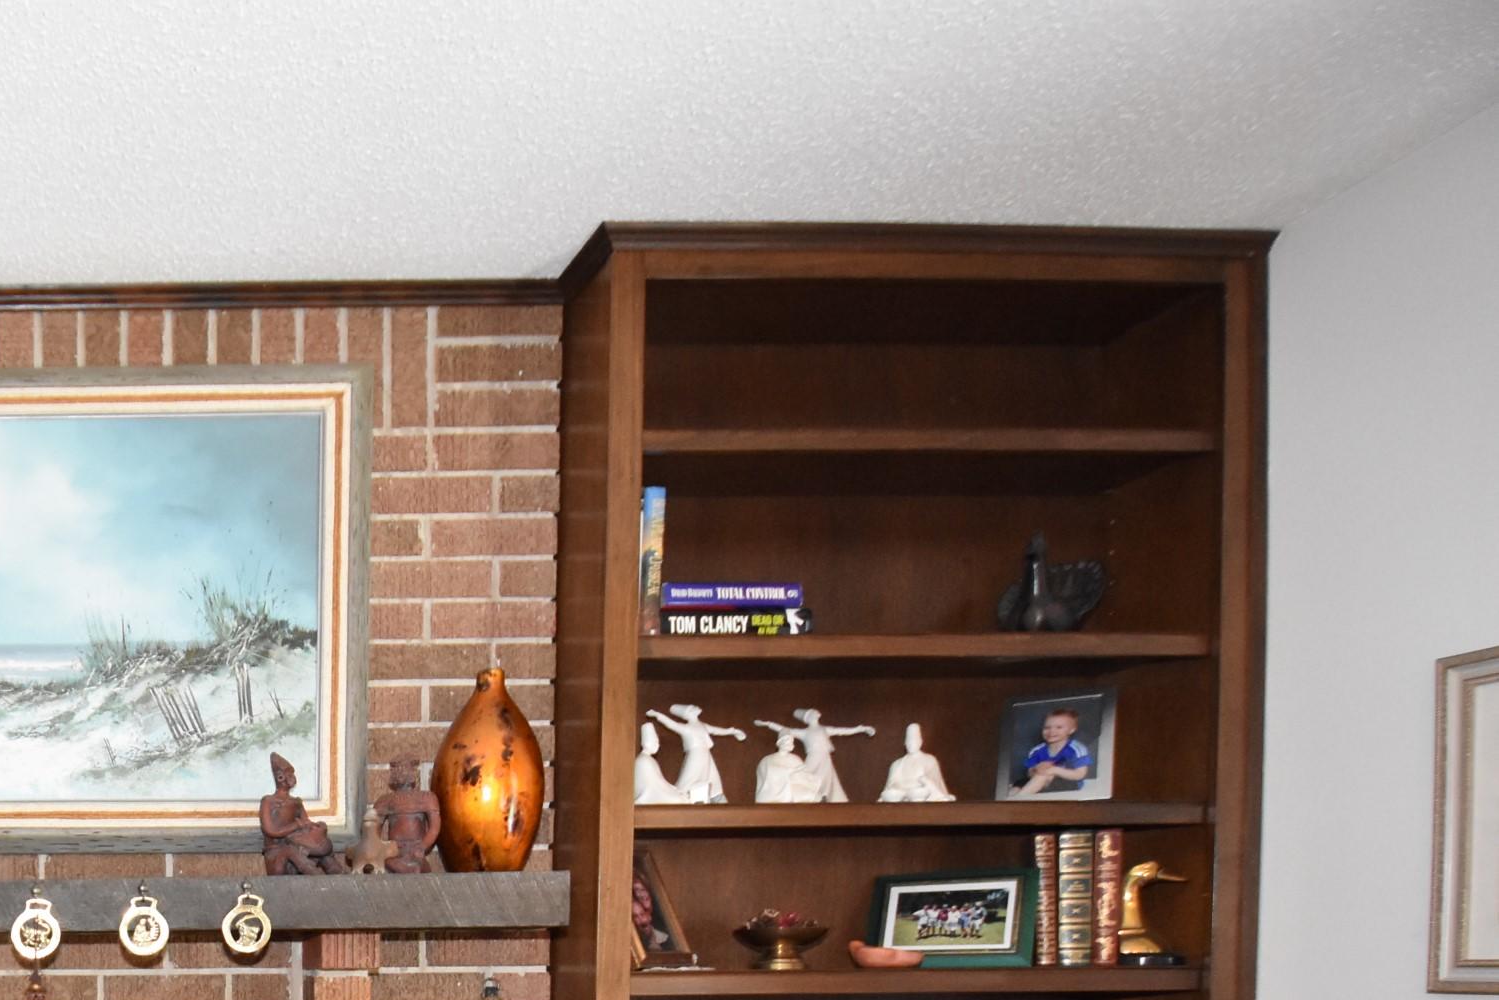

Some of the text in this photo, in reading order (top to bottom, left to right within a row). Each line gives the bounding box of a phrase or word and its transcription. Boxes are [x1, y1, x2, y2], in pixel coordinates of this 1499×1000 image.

[716, 586, 744, 600] TOTAL
[668, 614, 749, 634] TOM CLANCY
